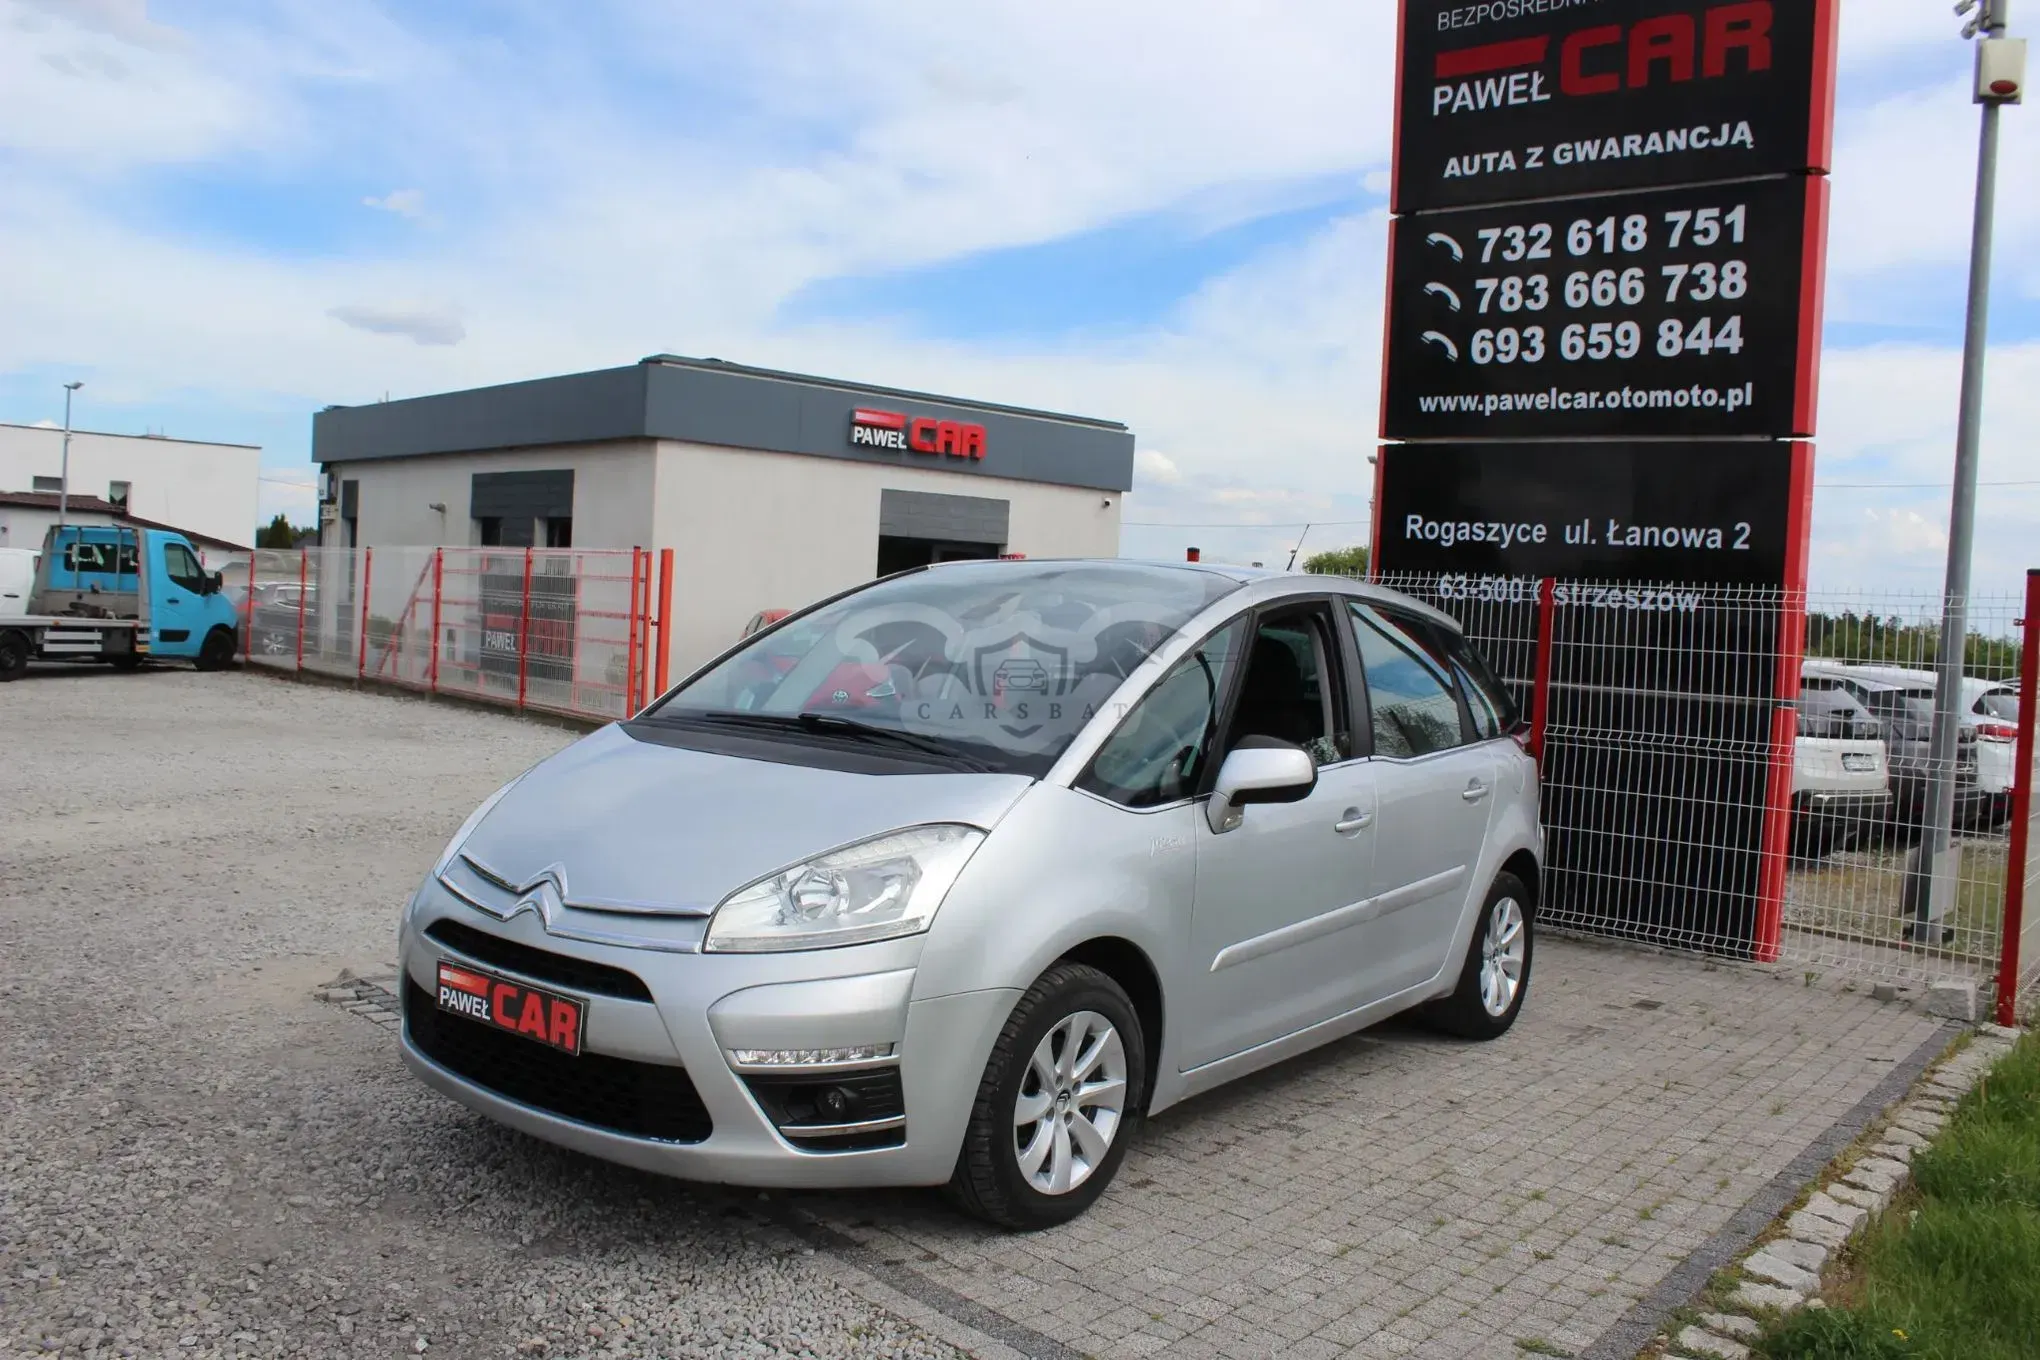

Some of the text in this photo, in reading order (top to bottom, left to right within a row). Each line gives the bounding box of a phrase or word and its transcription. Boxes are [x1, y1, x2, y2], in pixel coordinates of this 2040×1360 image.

[1433, 1, 1774, 116] PAWEŁ CAR
[1443, 120, 1754, 178] AUTA Z GWARANCJĄ
[1477, 204, 1747, 263] 732 618 751
[1475, 260, 1748, 314] 783 666 738
[1471, 315, 1744, 365] 693 659 844
[1419, 382, 1752, 416] www.pawelcar.otomoto.pl
[853, 417, 988, 460] PAWEŁ CAR
[1406, 514, 1751, 550] Rogaszyce ul. Łanowa 2
[1439, 574, 1522, 603] 63-500
[440, 983, 578, 1050] PAWEŁ CAR
